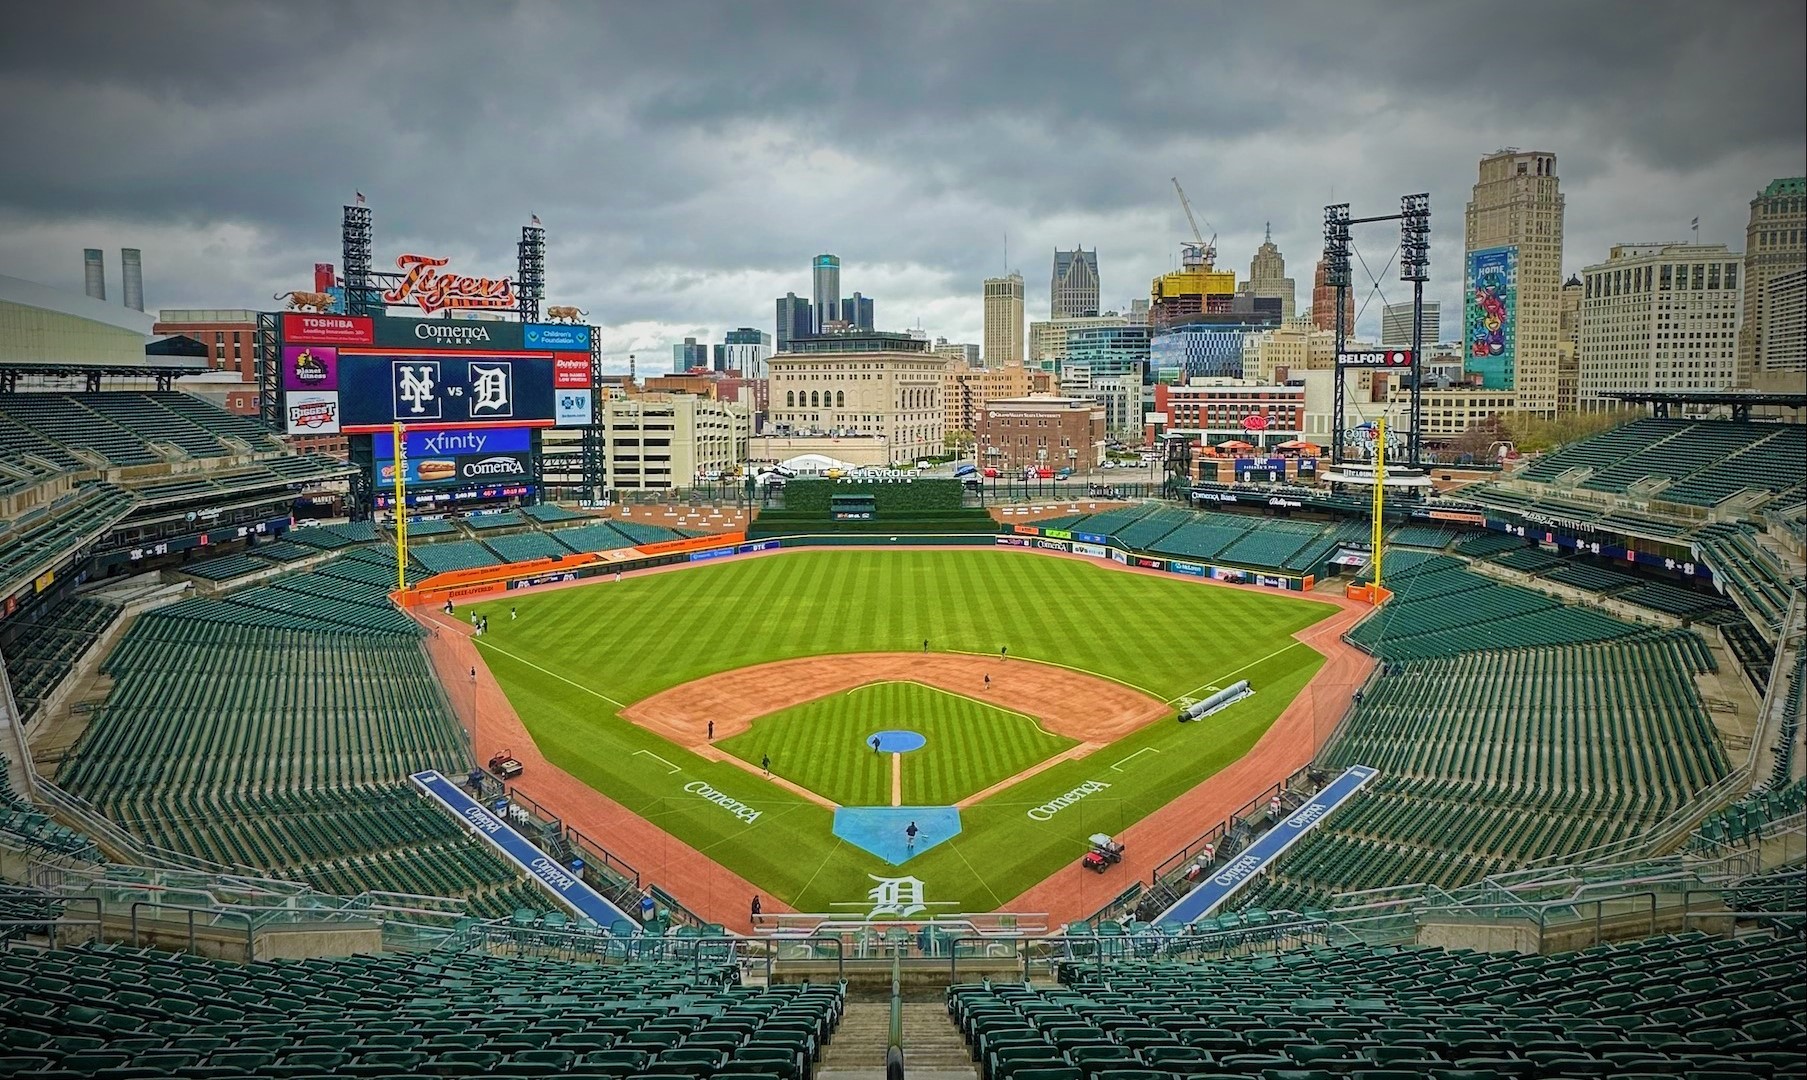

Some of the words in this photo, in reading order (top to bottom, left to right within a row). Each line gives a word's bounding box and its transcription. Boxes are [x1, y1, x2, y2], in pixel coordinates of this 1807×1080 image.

[384, 253, 515, 314] Tigers
[303, 318, 354, 328] TOSHIBA
[1338, 353, 1385, 364] BELFOR
[296, 367, 321, 376] planet
[291, 403, 335, 420] BIGGEST
[424, 431, 487, 454] xfinity
[851, 469, 922, 477] CHEVROLET
[312, 495, 336, 504] MARKET
[1220, 494, 1237, 502] Bank
